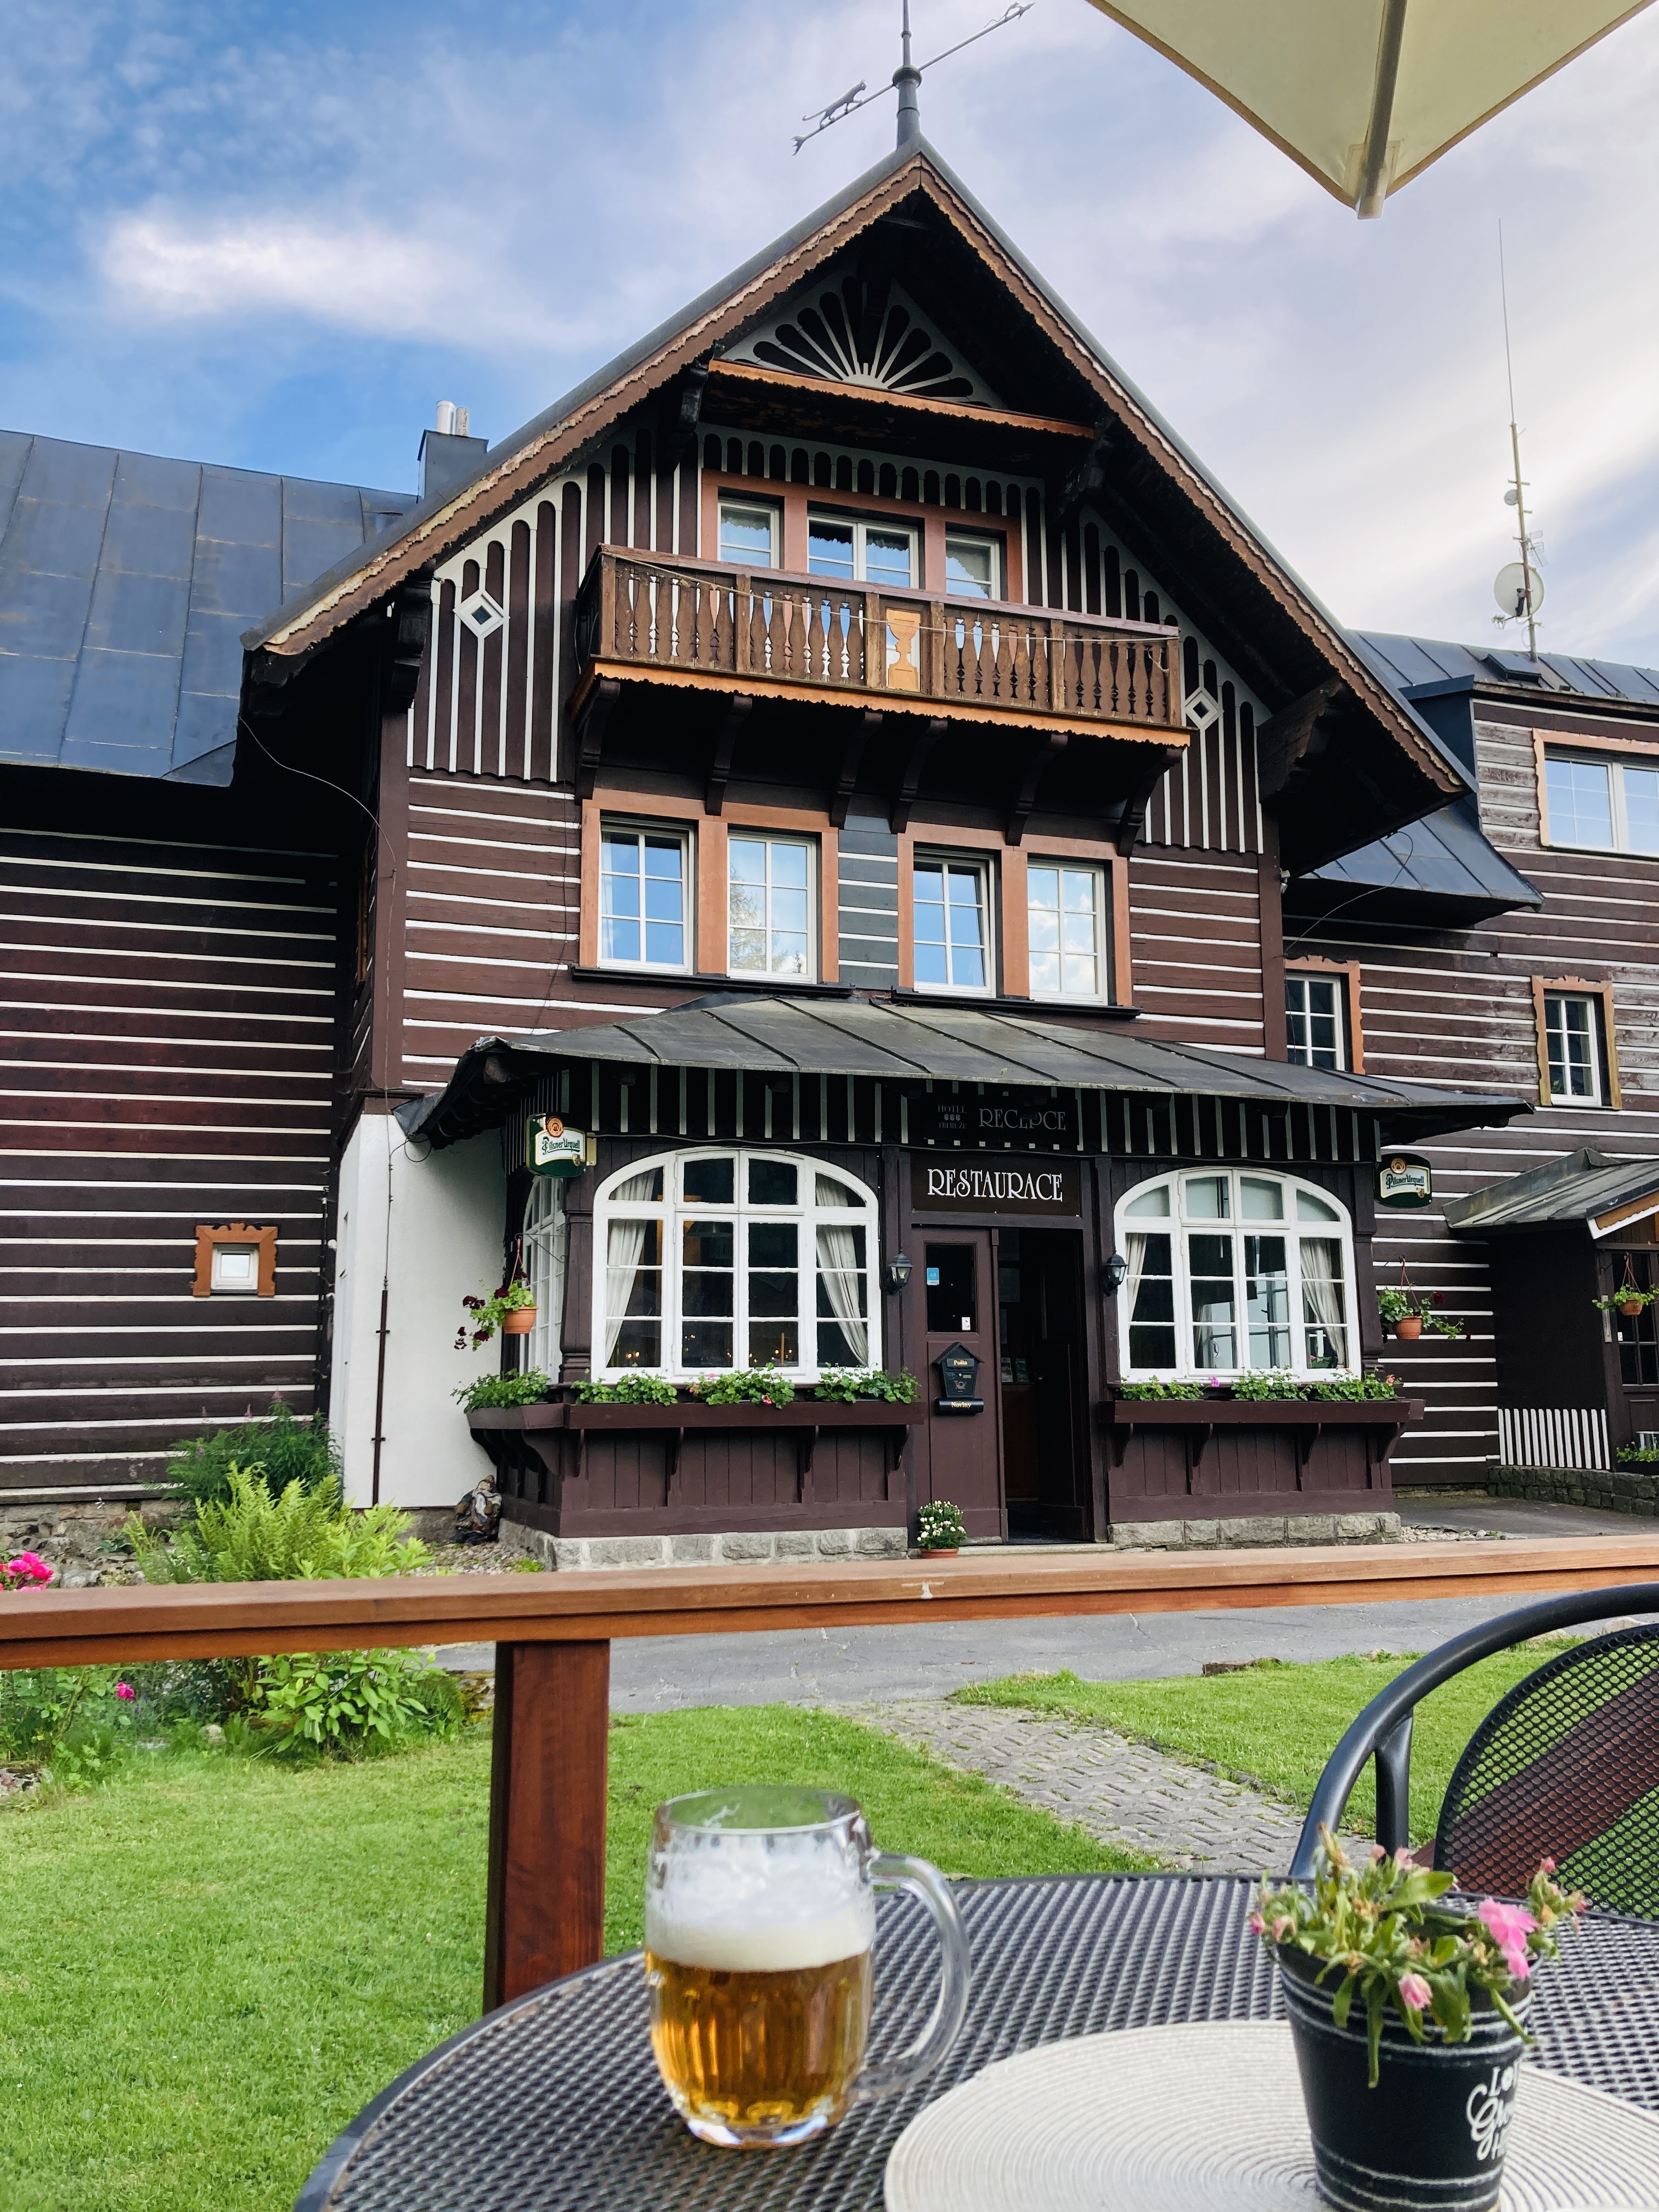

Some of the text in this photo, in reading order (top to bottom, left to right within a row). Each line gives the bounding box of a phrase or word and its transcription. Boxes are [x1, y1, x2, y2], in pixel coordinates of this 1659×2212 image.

[938, 1104, 967, 1114] HOTEL
[541, 1136, 580, 1155] Pilsner Urquell
[927, 1168, 1063, 1202] RESTAURACE
[1386, 1173, 1424, 1189] Pilsner Urquell
